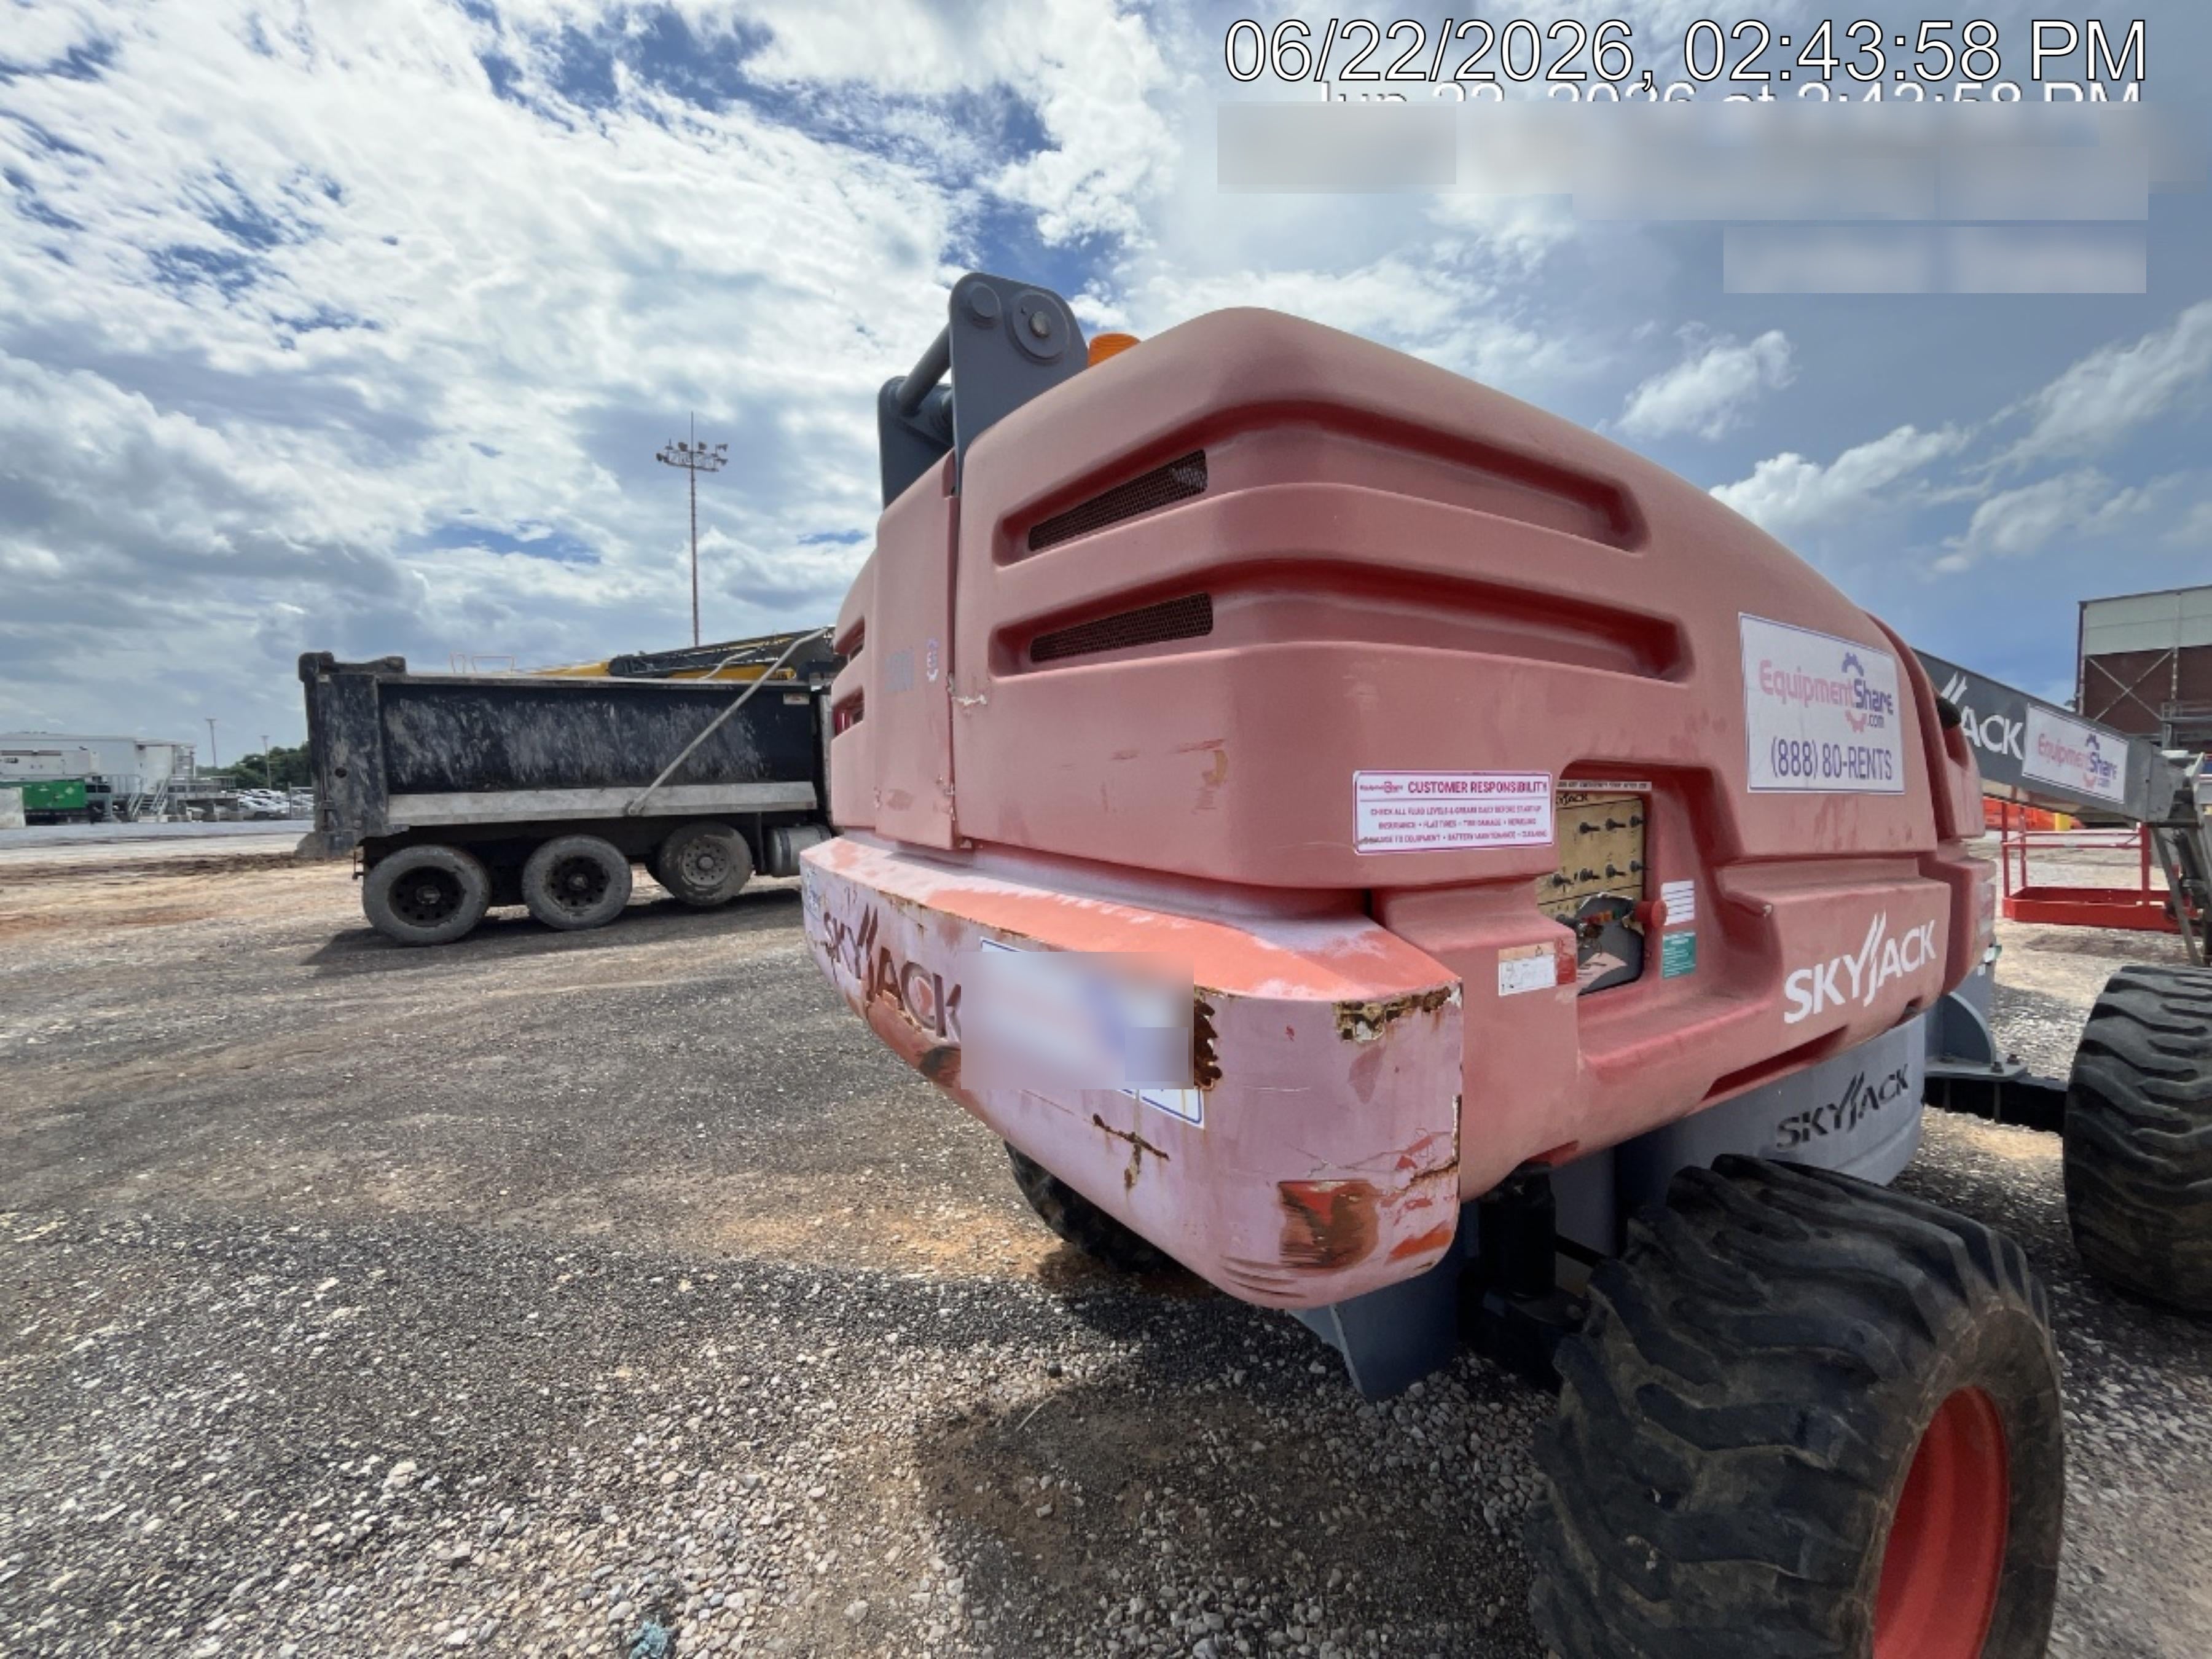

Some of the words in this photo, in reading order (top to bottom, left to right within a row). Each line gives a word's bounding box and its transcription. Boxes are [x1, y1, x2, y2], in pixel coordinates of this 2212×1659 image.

[1408, 781, 1468, 793] CUSTOMER
[1470, 781, 1547, 793] RESPONSIBILITY
[1771, 737, 1818, 779] (888)
[1822, 742, 1892, 780] 80-RENTS
[1784, 909, 1936, 1024] SKYJACK
[1776, 1064, 1908, 1150] SKYJACK
